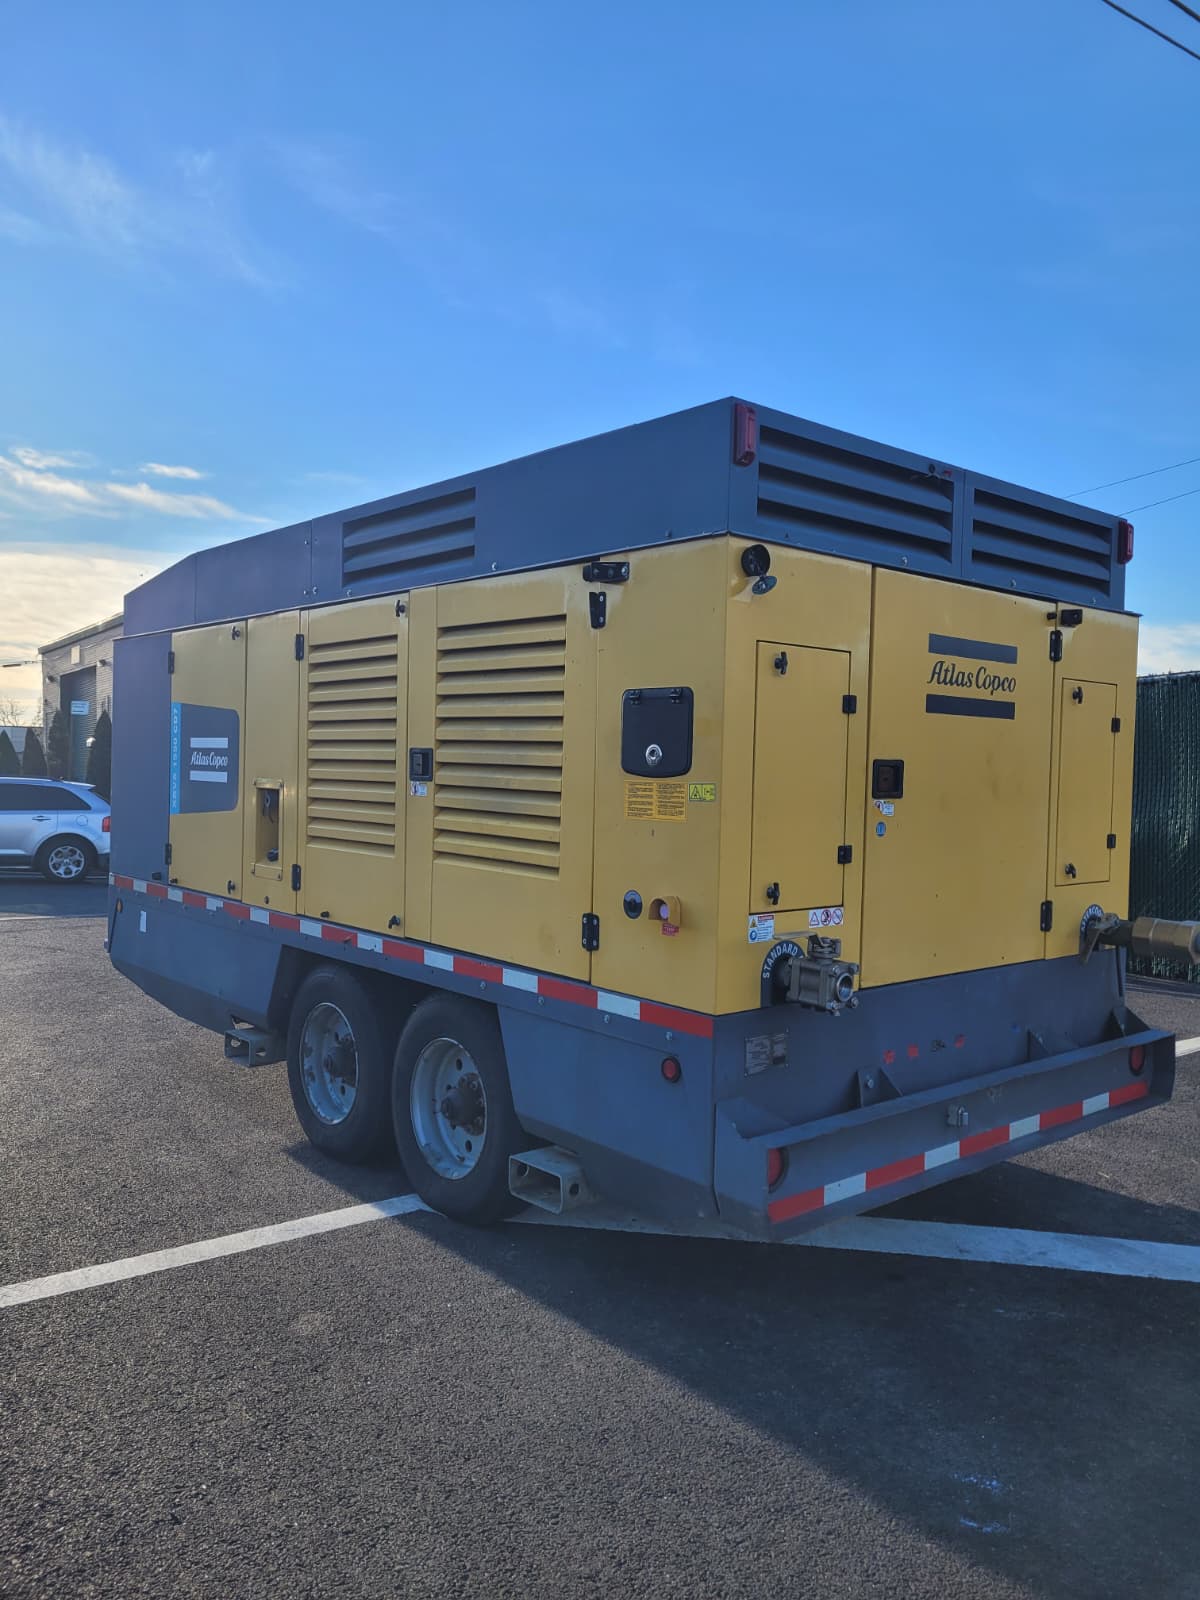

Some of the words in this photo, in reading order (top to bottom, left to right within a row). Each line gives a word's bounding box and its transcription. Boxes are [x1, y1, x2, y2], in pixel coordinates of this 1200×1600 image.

[927, 660, 974, 688] Atlas
[975, 666, 1017, 696] Copco
[190, 751, 210, 766] Atlas
[208, 751, 229, 769] Copco
[762, 942, 799, 979] STANDARD
